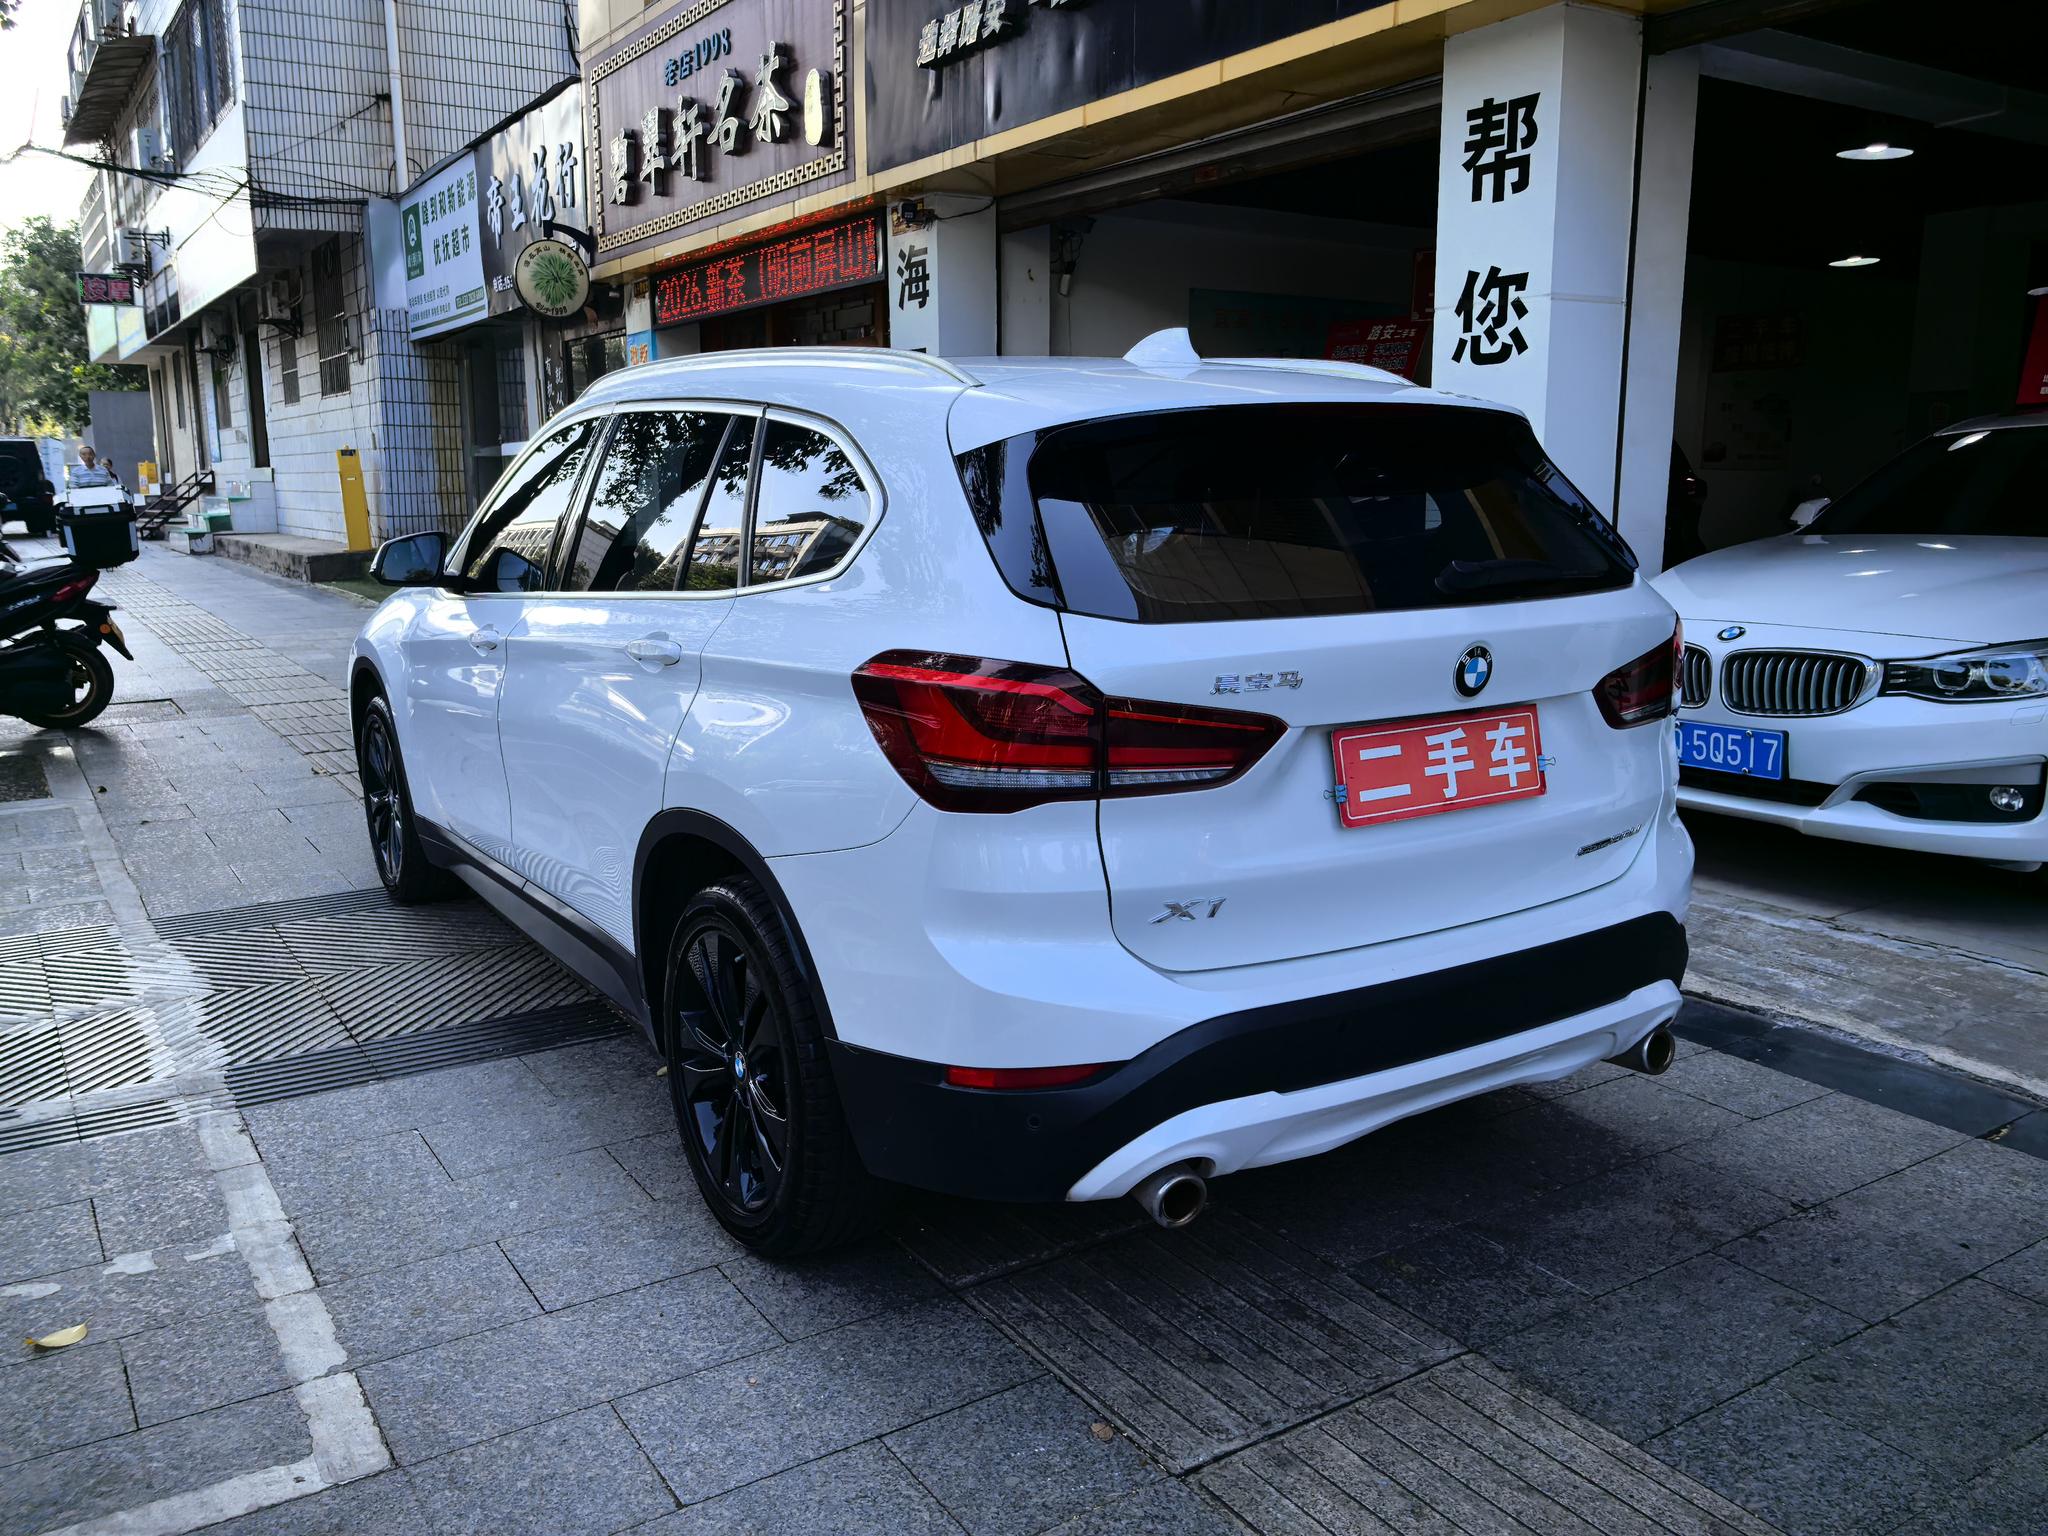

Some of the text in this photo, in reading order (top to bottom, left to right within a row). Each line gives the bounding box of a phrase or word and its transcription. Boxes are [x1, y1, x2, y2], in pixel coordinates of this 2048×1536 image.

[664, 27, 732, 86] 老店1998
[1452, 92, 1541, 366] 帮您
[83, 277, 132, 302] 按摩
[897, 245, 930, 311] 海
[1209, 670, 1303, 695] 晨宝马
[1359, 721, 1532, 802] 二手车
[1151, 897, 1227, 924] X1
